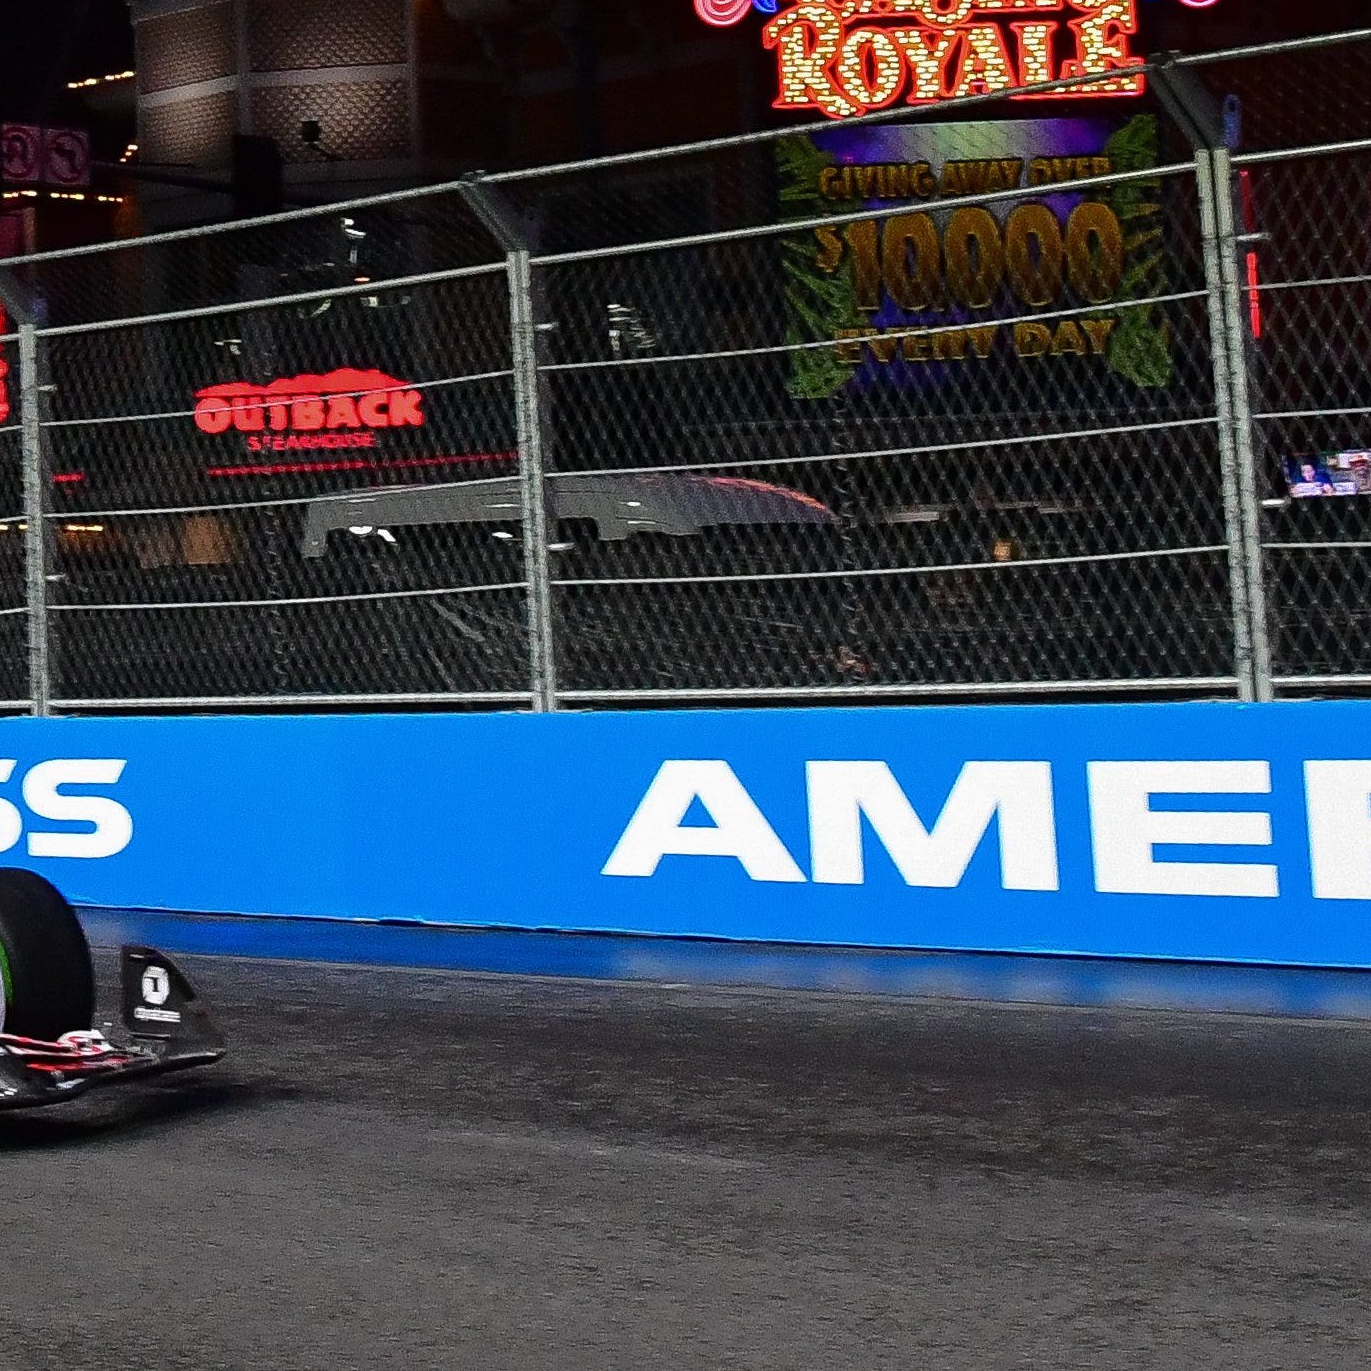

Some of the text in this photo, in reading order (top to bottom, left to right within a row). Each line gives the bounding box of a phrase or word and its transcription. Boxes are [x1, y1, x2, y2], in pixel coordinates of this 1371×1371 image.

[819, 161, 935, 200] GIVING
[940, 157, 1023, 195] AWAY
[833, 319, 1116, 364] EVERY DAY
[194, 389, 425, 434] OUTBACK
